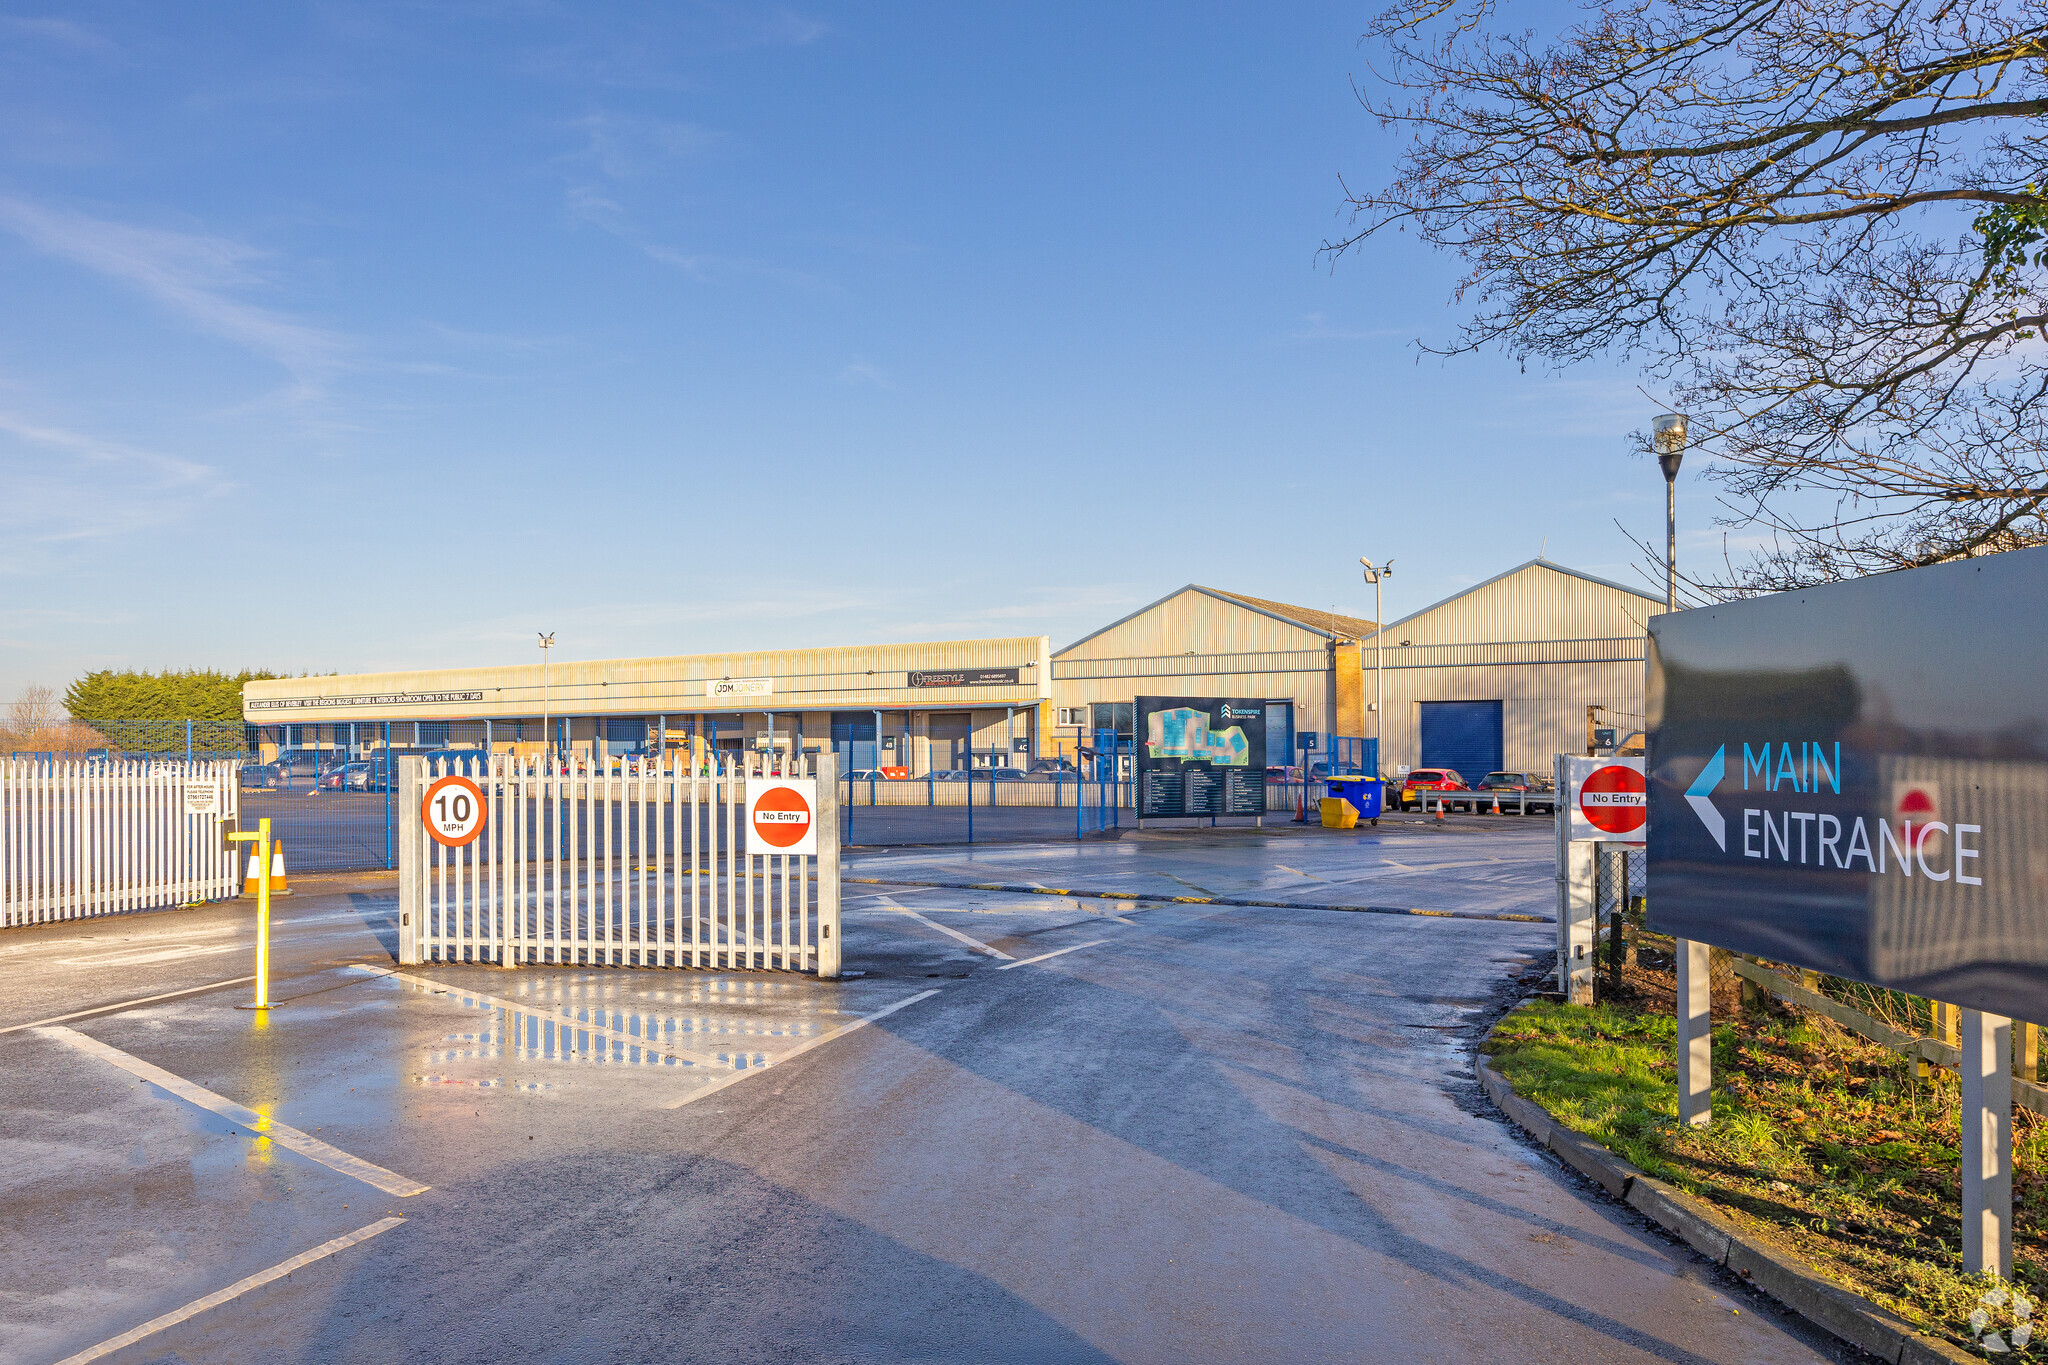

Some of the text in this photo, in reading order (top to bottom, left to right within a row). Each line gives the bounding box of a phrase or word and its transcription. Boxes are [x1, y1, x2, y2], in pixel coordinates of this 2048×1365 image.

[923, 674, 964, 682] FREESTYLE
[734, 683, 764, 692] JOINERY
[1744, 742, 1840, 794] MAIN
[1593, 794, 1641, 805] No Entry
[435, 794, 470, 822] 10
[778, 812, 800, 822] Entry
[1744, 808, 1982, 886] ENTRANCE
